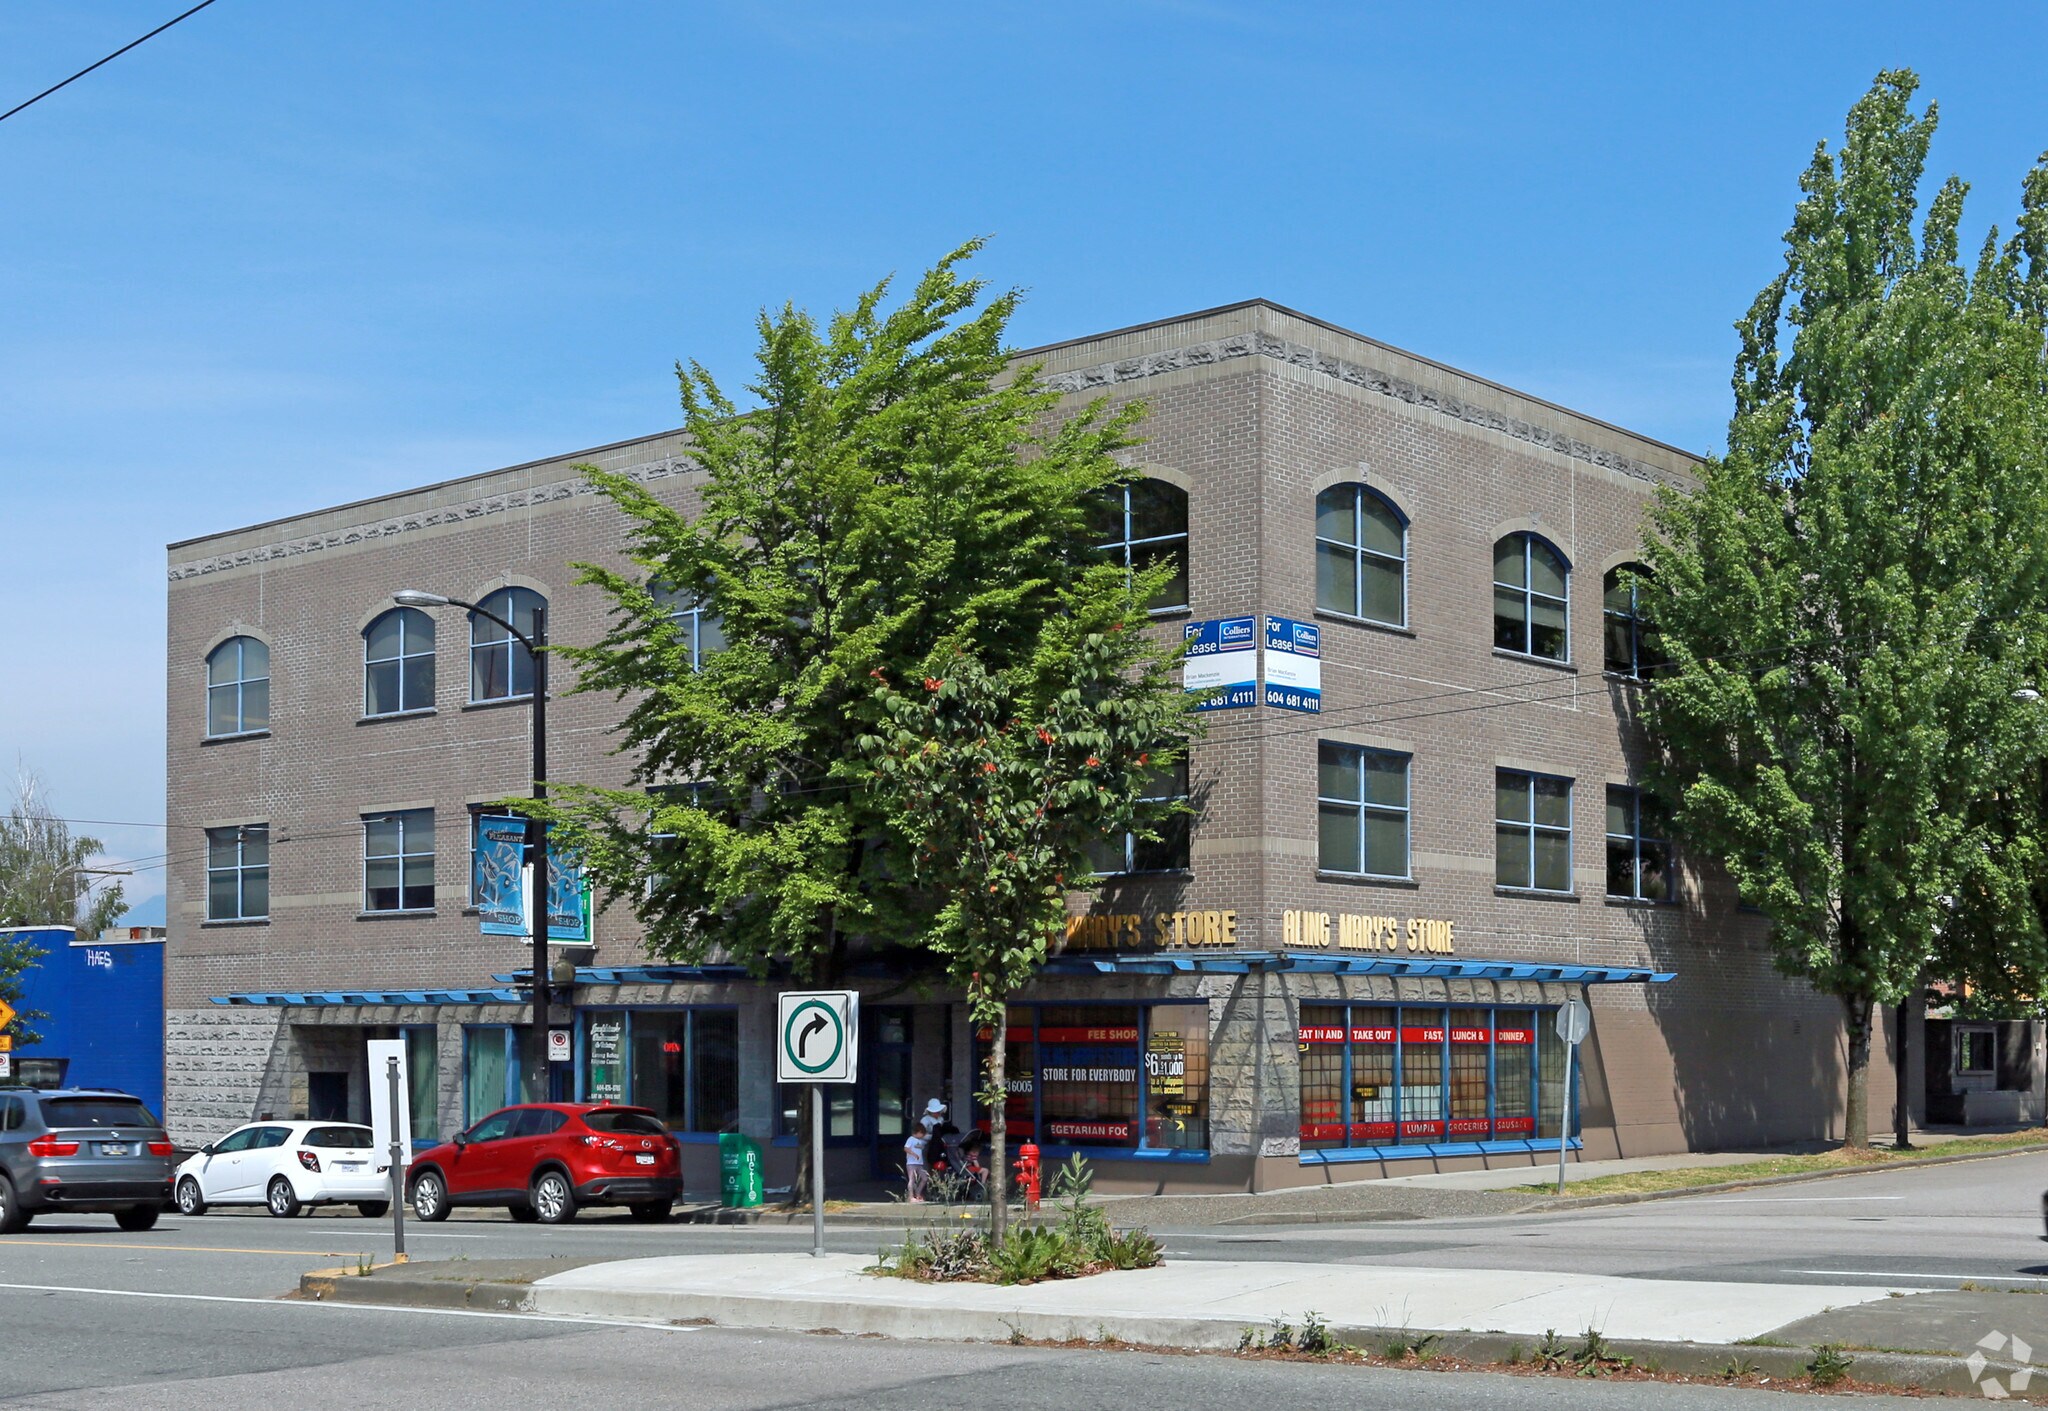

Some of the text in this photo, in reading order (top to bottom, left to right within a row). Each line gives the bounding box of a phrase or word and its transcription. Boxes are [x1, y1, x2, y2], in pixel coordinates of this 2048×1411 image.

[1223, 626, 1251, 636] Colliers
[1265, 617, 1281, 632] For
[1185, 625, 1204, 639] For
[1296, 629, 1316, 642] Colliers
[1185, 642, 1217, 655] Lease
[1266, 634, 1293, 651] Lease
[1232, 691, 1254, 704] 4111
[1267, 690, 1319, 710] 604 681 4111
[498, 914, 521, 925] SHOP
[1154, 910, 1236, 947] STORE
[1283, 910, 1454, 954] ALING MARY'S STORE
[1299, 1030, 1313, 1039] EAT
[1315, 1030, 1324, 1039] IN
[1326, 1030, 1343, 1040] AND
[1353, 1031, 1374, 1040] TAKE
[1375, 1031, 1392, 1040] OUT
[1452, 1031, 1476, 1041] LUNCH
[1478, 1032, 1484, 1040] &
[663, 1043, 680, 1052] OPEN
[1043, 1068, 1068, 1081] STORE
[1071, 1068, 1087, 1081] FOR
[1089, 1068, 1136, 1082] EVERYBODY
[1406, 1124, 1435, 1134] LUMPIA
[1448, 1121, 1488, 1132] GROCERIES
